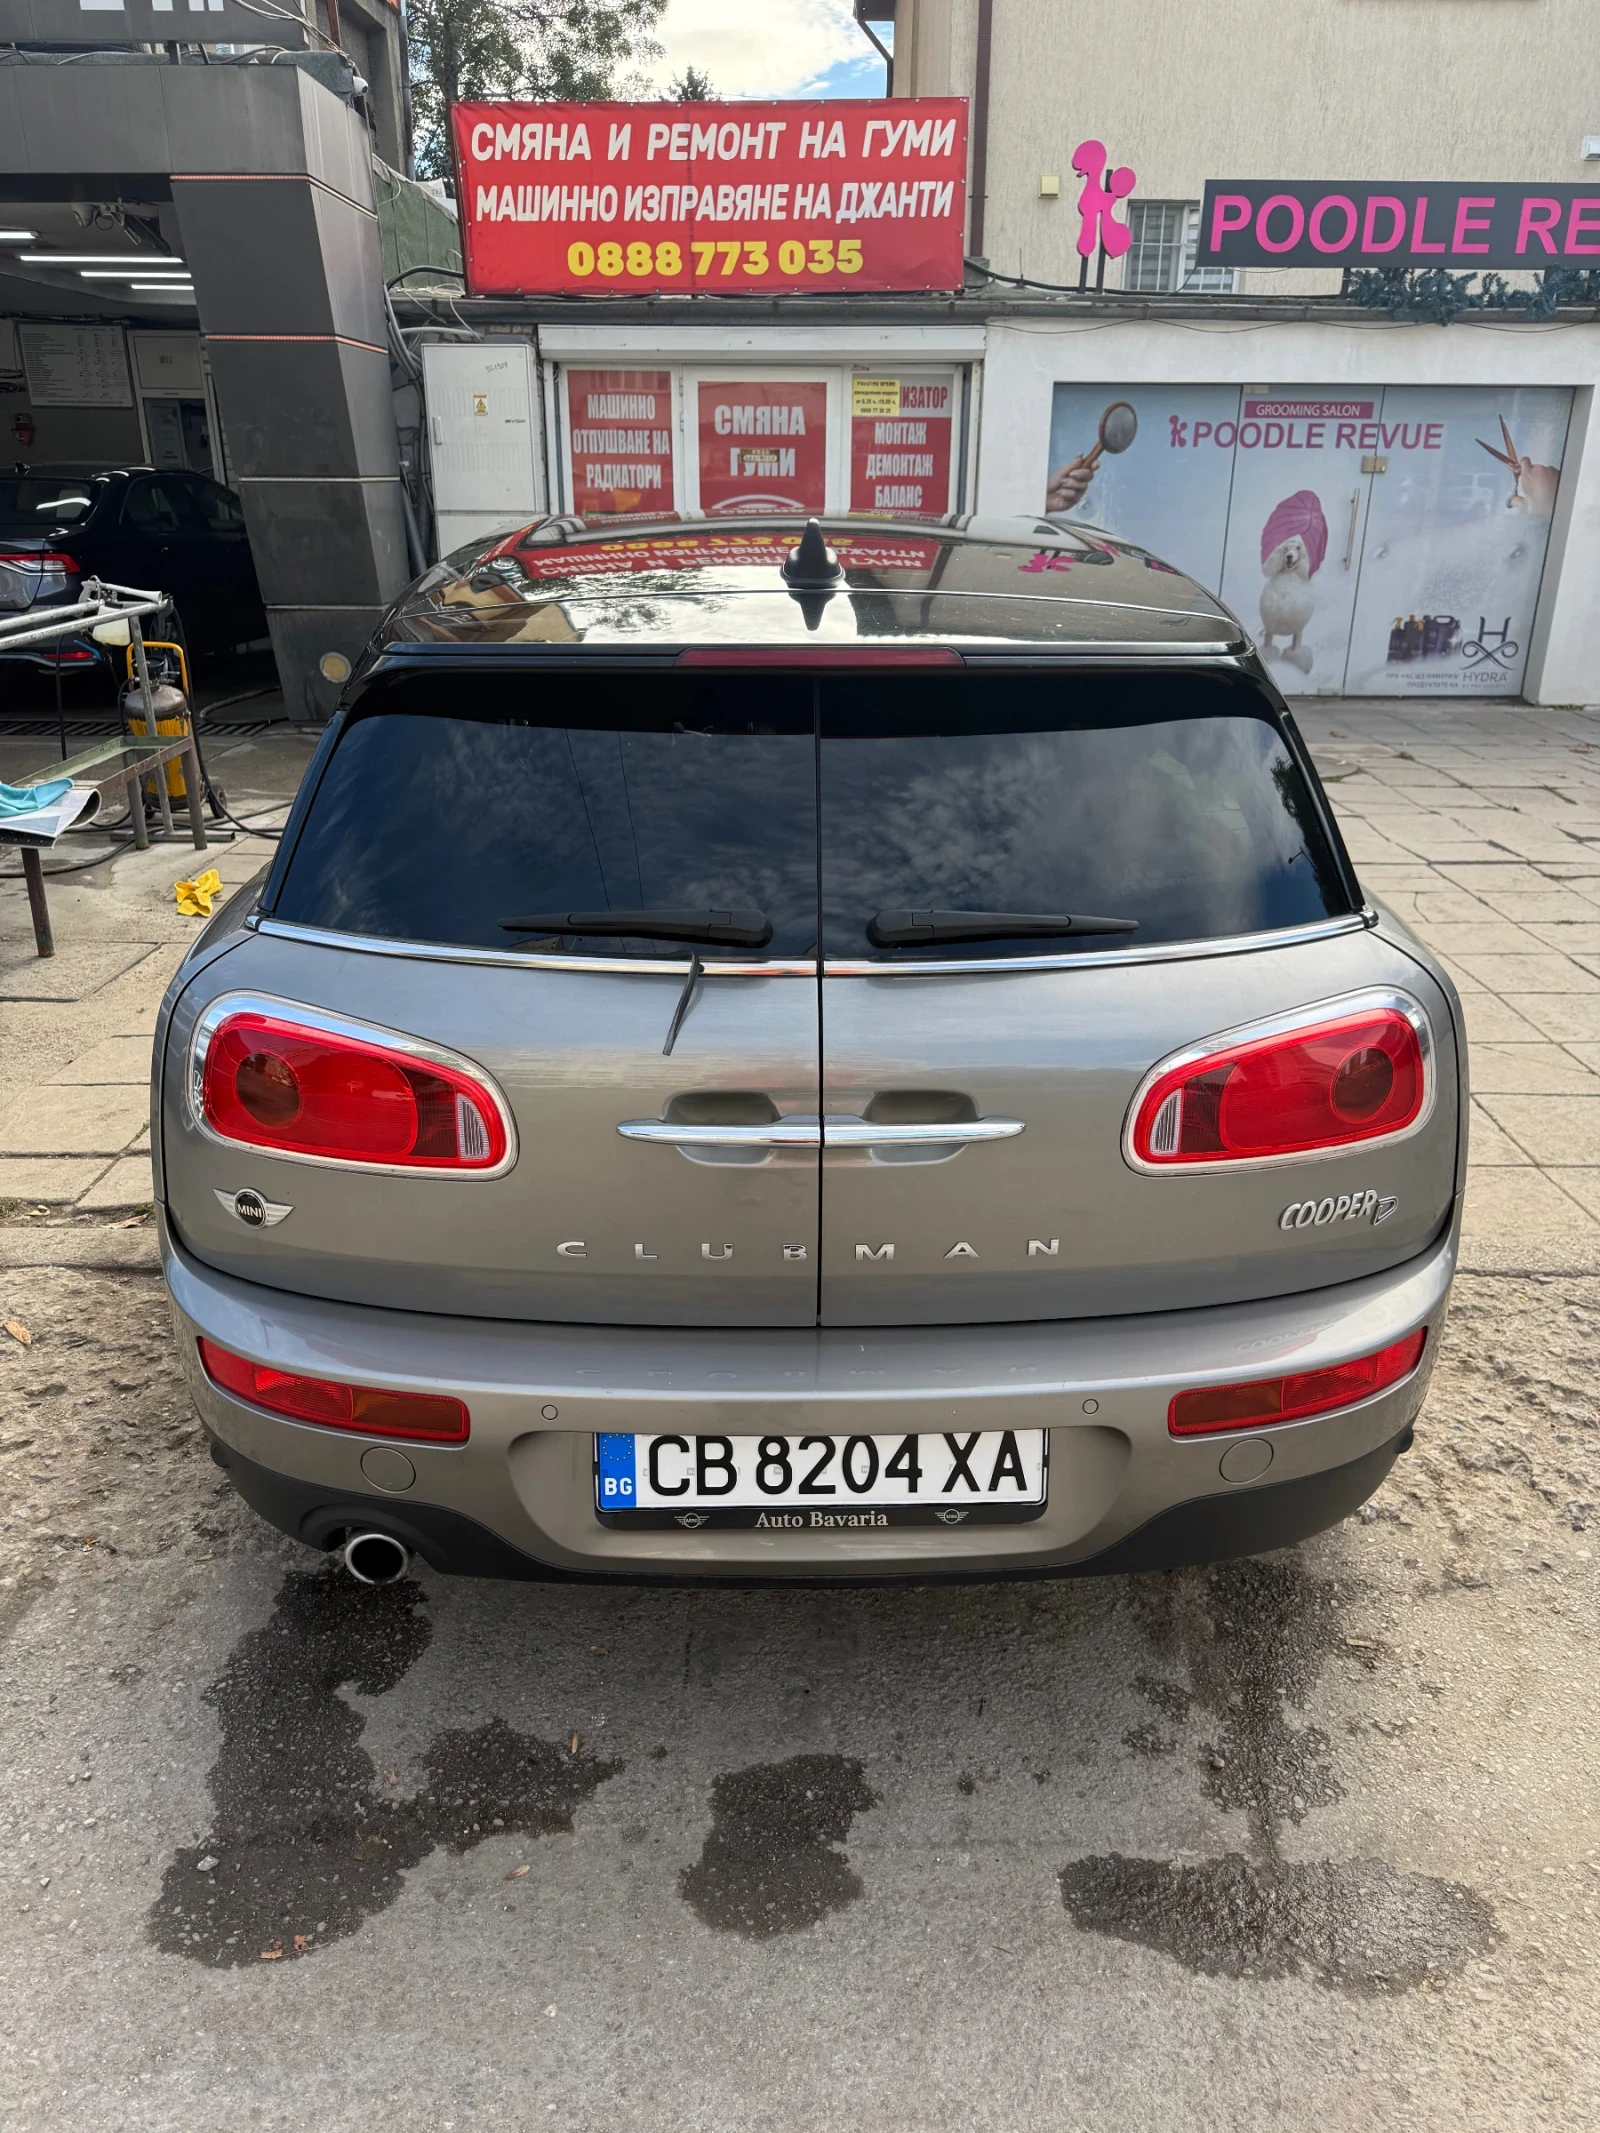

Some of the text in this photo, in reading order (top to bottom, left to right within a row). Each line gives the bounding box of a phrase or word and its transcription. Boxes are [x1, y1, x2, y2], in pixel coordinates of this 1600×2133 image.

[471, 119, 957, 161] СМЯНА И РЕМОНТ НА ГУМИ
[475, 180, 955, 224] МАШИННО ИЗПРАВЯНЕ НА ДЖАНТИ
[1210, 194, 1600, 255] POODLE RE
[567, 239, 864, 276] 0888 773 035
[587, 394, 656, 420] МАШИННО
[900, 386, 948, 409] ИЗАТОР
[1256, 404, 1361, 417] GROOMING SALON
[714, 404, 807, 436] СМЯНА
[573, 429, 671, 455] ОТПУШВАНЕ НА
[874, 422, 927, 445] МОНТАЖ
[1192, 421, 1445, 450] POODLE REVUE
[586, 463, 662, 491] РАДИАТОРИ
[865, 453, 934, 480] ДЕМОНТАЖ
[874, 485, 923, 508] БАЛАНС
[1462, 671, 1507, 683] HYDRA
[237, 1203, 263, 1218] MINI
[1278, 1188, 1378, 1231] COOPER
[556, 1238, 1060, 1262] CLUBMAN
[604, 1432, 1028, 1497] BG CB 8204 XA
[754, 1510, 889, 1528] Auto Bavaria
